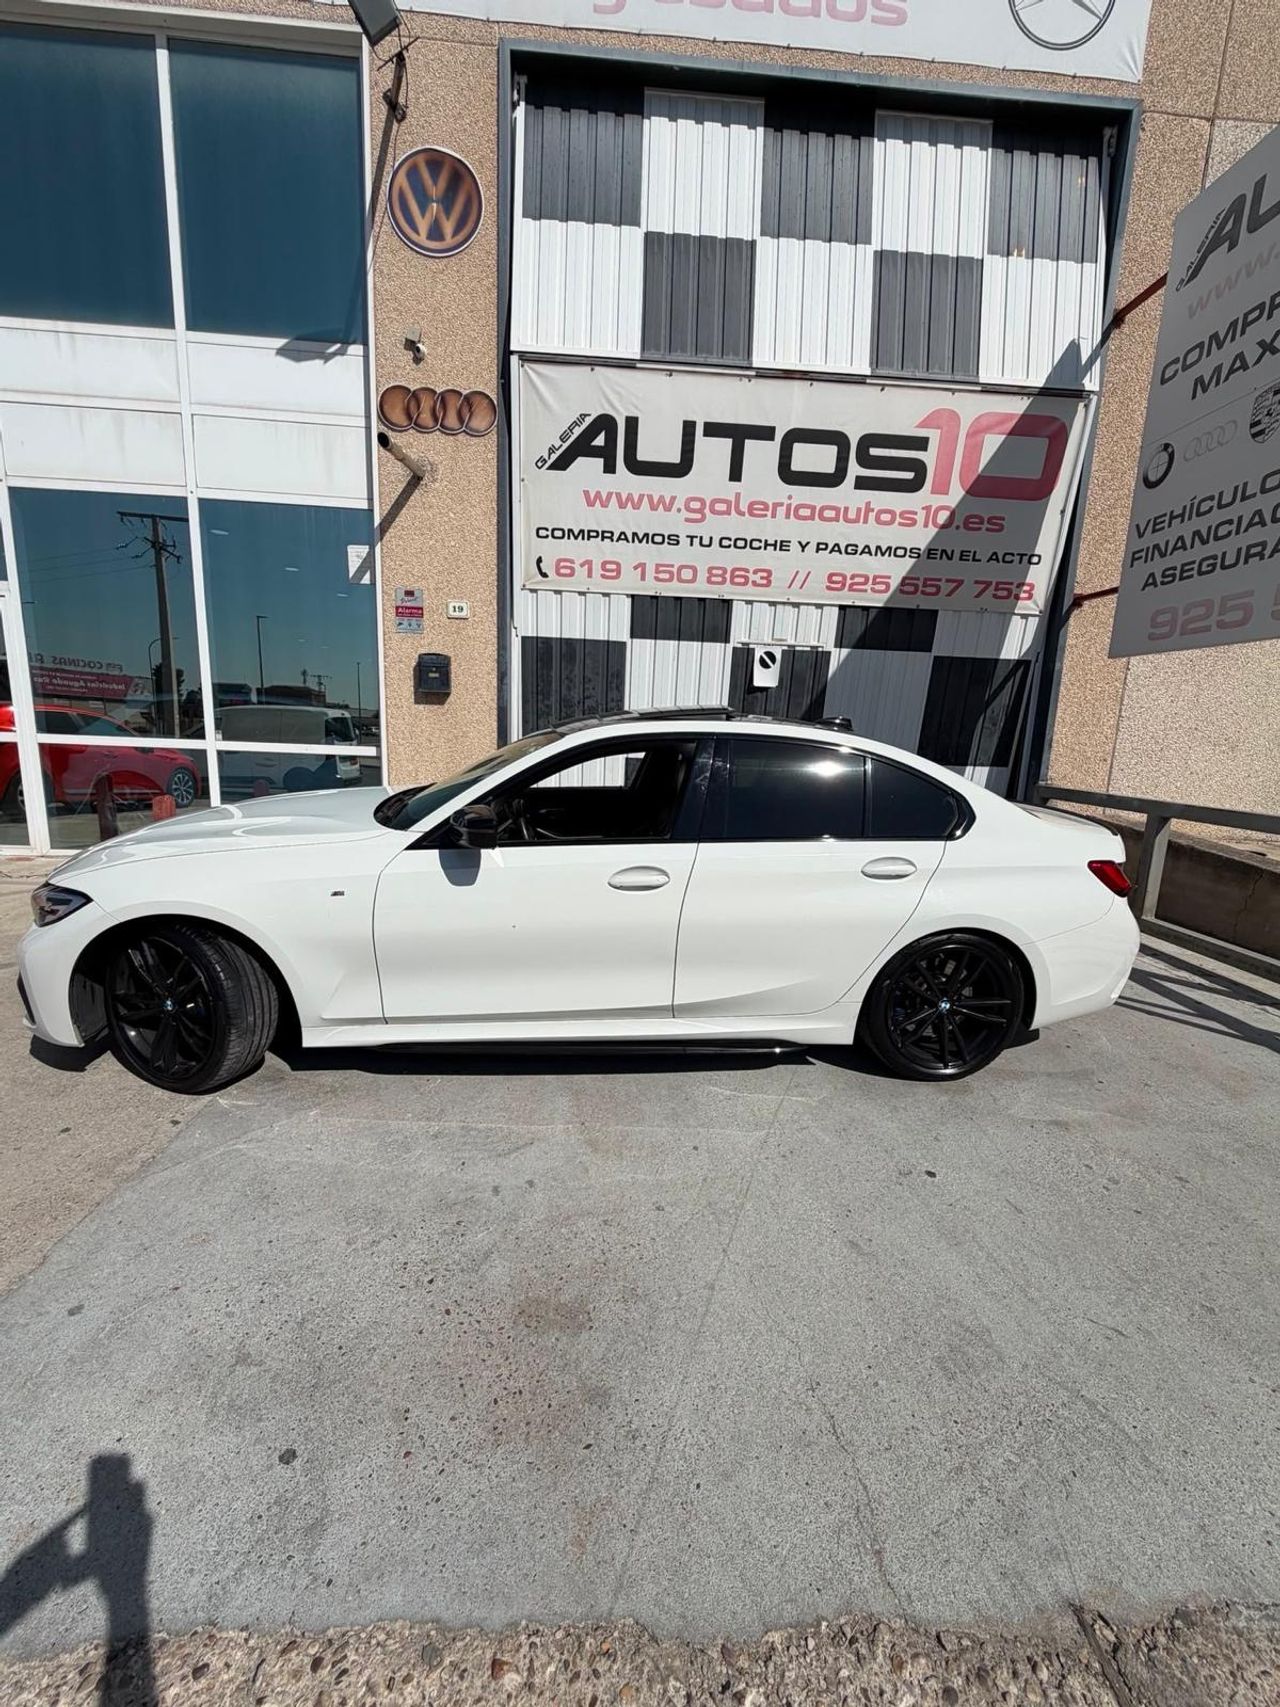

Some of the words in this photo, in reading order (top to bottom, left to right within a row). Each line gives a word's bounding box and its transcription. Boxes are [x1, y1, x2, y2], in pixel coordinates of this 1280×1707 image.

[534, 412, 592, 470] GALERIA
[545, 407, 1069, 501] AUTOS10
[582, 489, 1006, 533] www.galeriaautos10.es
[535, 526, 681, 546] COMPRAMOS
[686, 534, 713, 548] TU
[718, 536, 791, 551] COCHE
[797, 540, 811, 552] Y
[815, 542, 921, 559] PAGAMOS
[926, 549, 955, 561] EN
[959, 550, 982, 562] EL
[986, 552, 1042, 565] ACTO
[554, 557, 622, 580] 619
[632, 562, 698, 584] 150
[706, 566, 773, 588] 863
[825, 571, 891, 594] 925
[900, 576, 964, 597] 557
[973, 579, 1036, 602] 753
[452, 605, 464, 613] 19
[1148, 589, 1255, 641] 925
